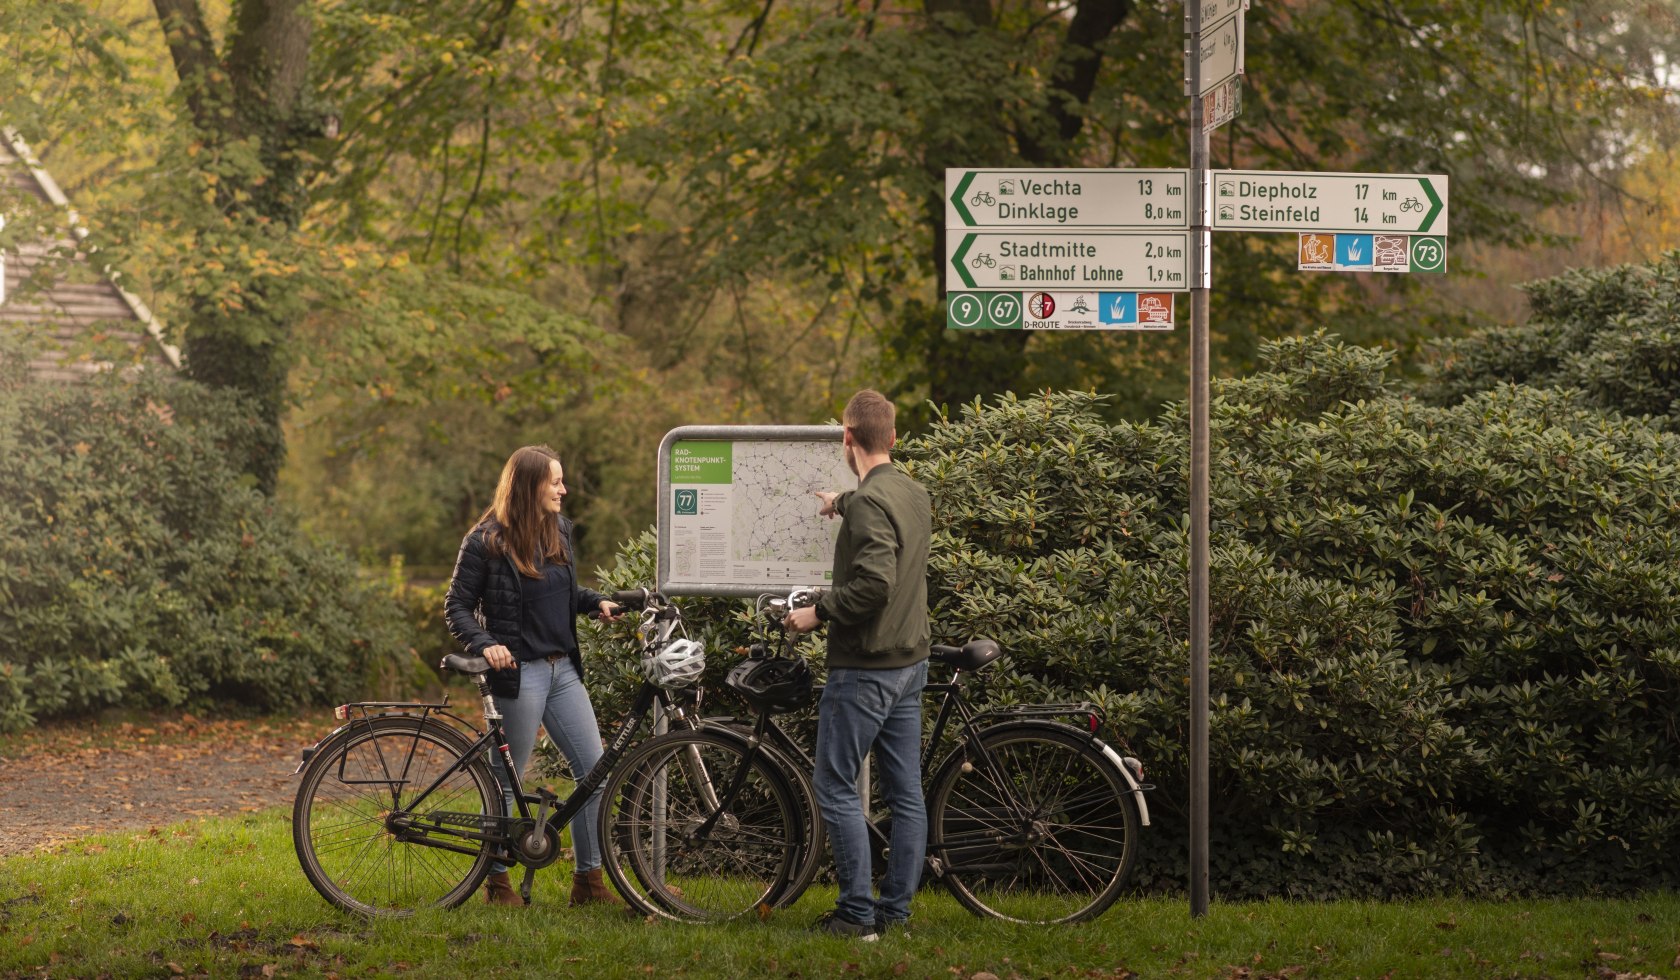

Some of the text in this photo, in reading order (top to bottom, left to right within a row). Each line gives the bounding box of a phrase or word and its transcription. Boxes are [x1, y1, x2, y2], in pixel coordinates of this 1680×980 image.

[1020, 179, 1181, 196] Vechta 13 km
[1239, 181, 1397, 202] Diepholz 17 km
[998, 202, 1182, 223] Dinklage 8,0 km
[1239, 204, 1397, 224] Steinfeld 14 km
[999, 241, 1182, 259] Stadtmitte 2,0 km
[1418, 245, 1438, 262] 73
[1020, 264, 1182, 282] Bahnhof Lohne 1,9 km
[961, 302, 971, 318] 9
[994, 301, 1014, 318] 67
[1044, 301, 1052, 311] 7
[1024, 320, 1060, 329] D-ROUTE
[675, 448, 692, 456] RAD-
[675, 456, 726, 464] KNOTENPUNKT-
[674, 464, 700, 472] SYSTEM
[680, 494, 692, 507] 77
[612, 717, 637, 751] KETTLER
